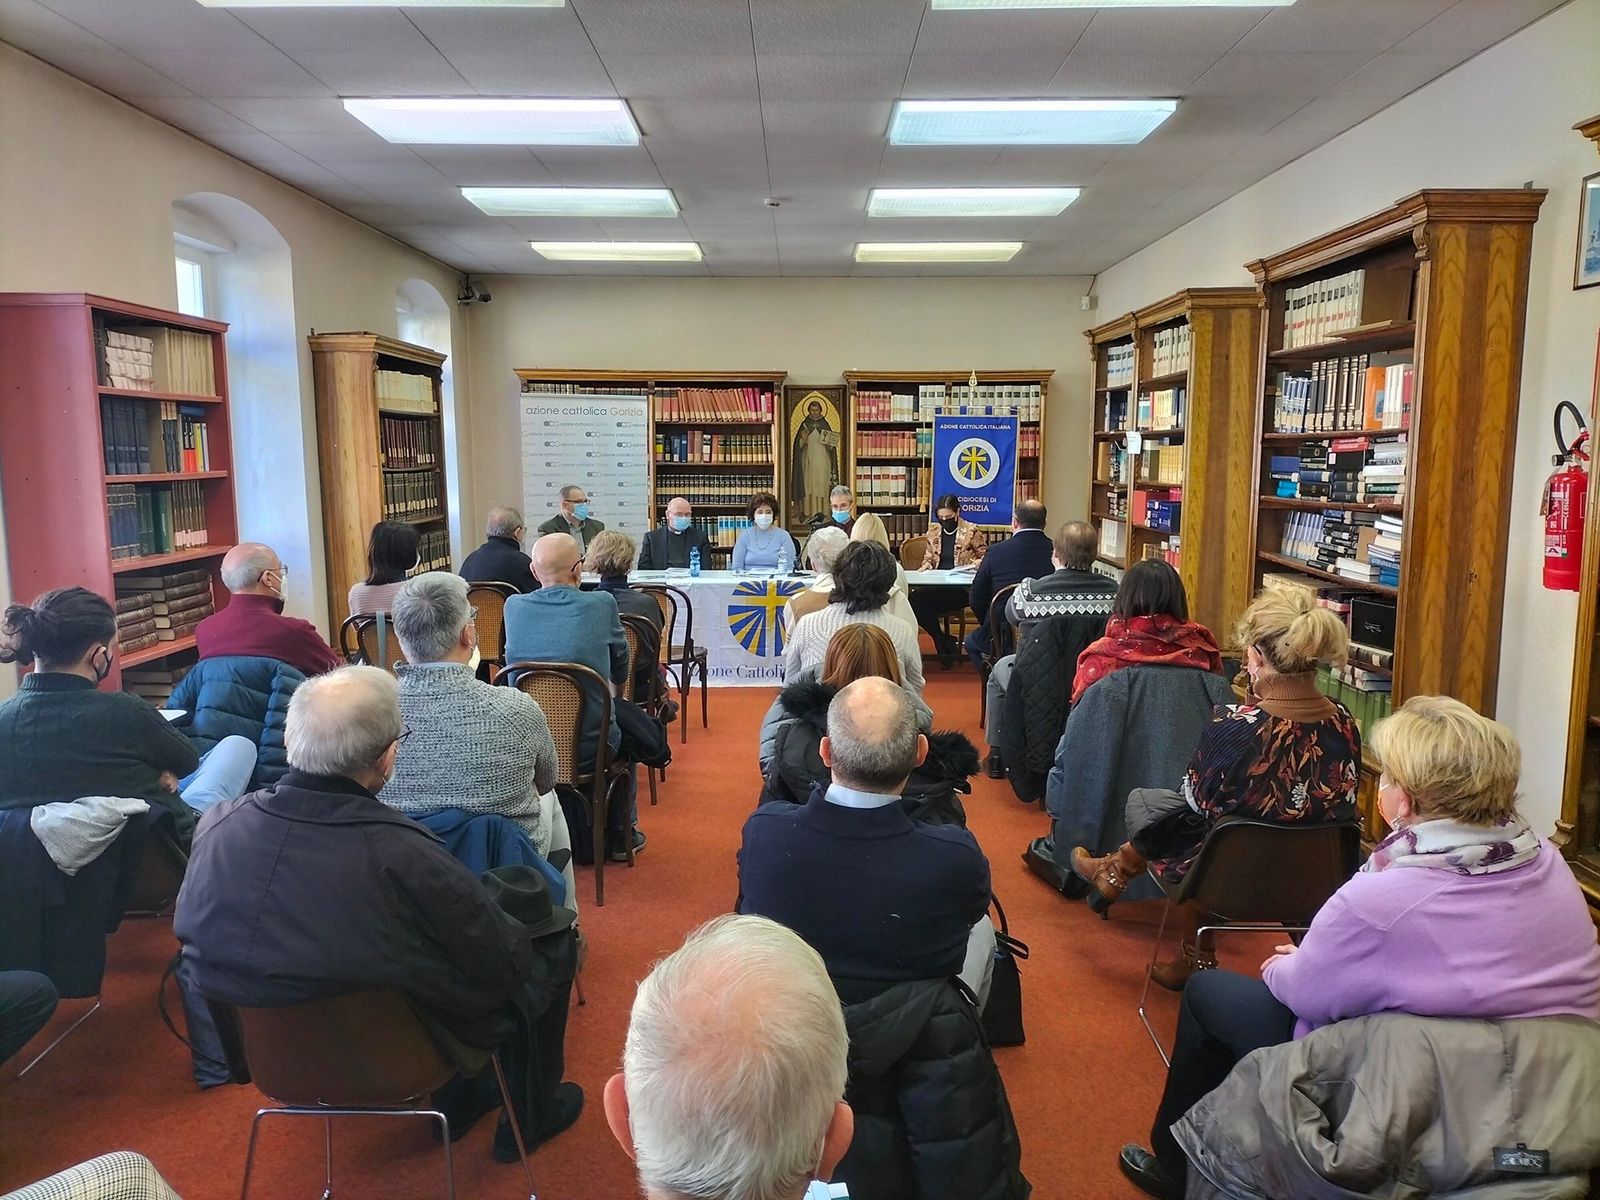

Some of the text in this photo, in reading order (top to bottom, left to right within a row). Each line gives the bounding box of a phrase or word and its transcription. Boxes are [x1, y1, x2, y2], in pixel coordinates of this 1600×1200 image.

[525, 406, 643, 416] azione cattolica Gorizia
[962, 504, 990, 512] ORIZIA
[736, 663, 786, 679] Cattoli
